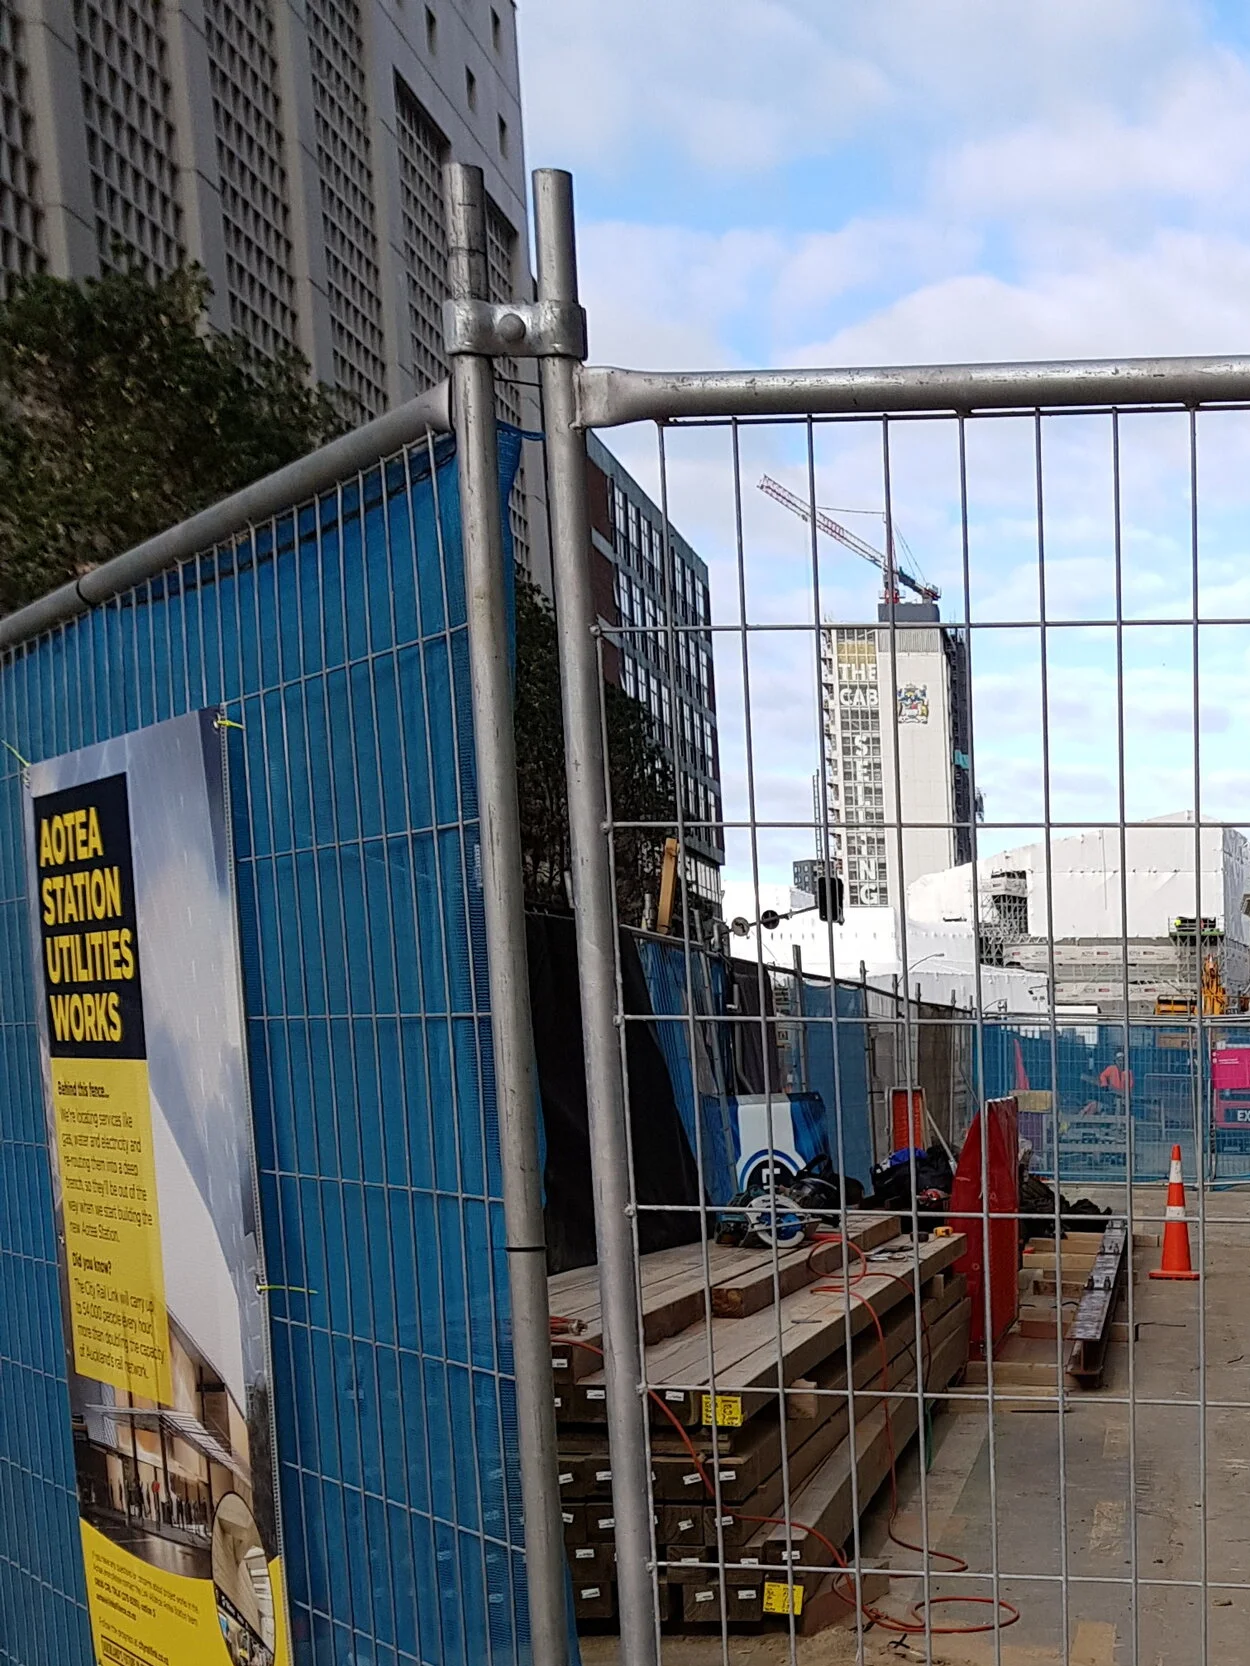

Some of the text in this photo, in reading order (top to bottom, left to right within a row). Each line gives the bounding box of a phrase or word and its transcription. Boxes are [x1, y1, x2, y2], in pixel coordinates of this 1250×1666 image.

[838, 663, 877, 681] THE
[840, 688, 879, 706] CAB
[40, 806, 104, 868] AOTEA
[42, 865, 122, 926] STATION
[46, 927, 136, 984] UTILITIES
[50, 991, 123, 1042] WORKS
